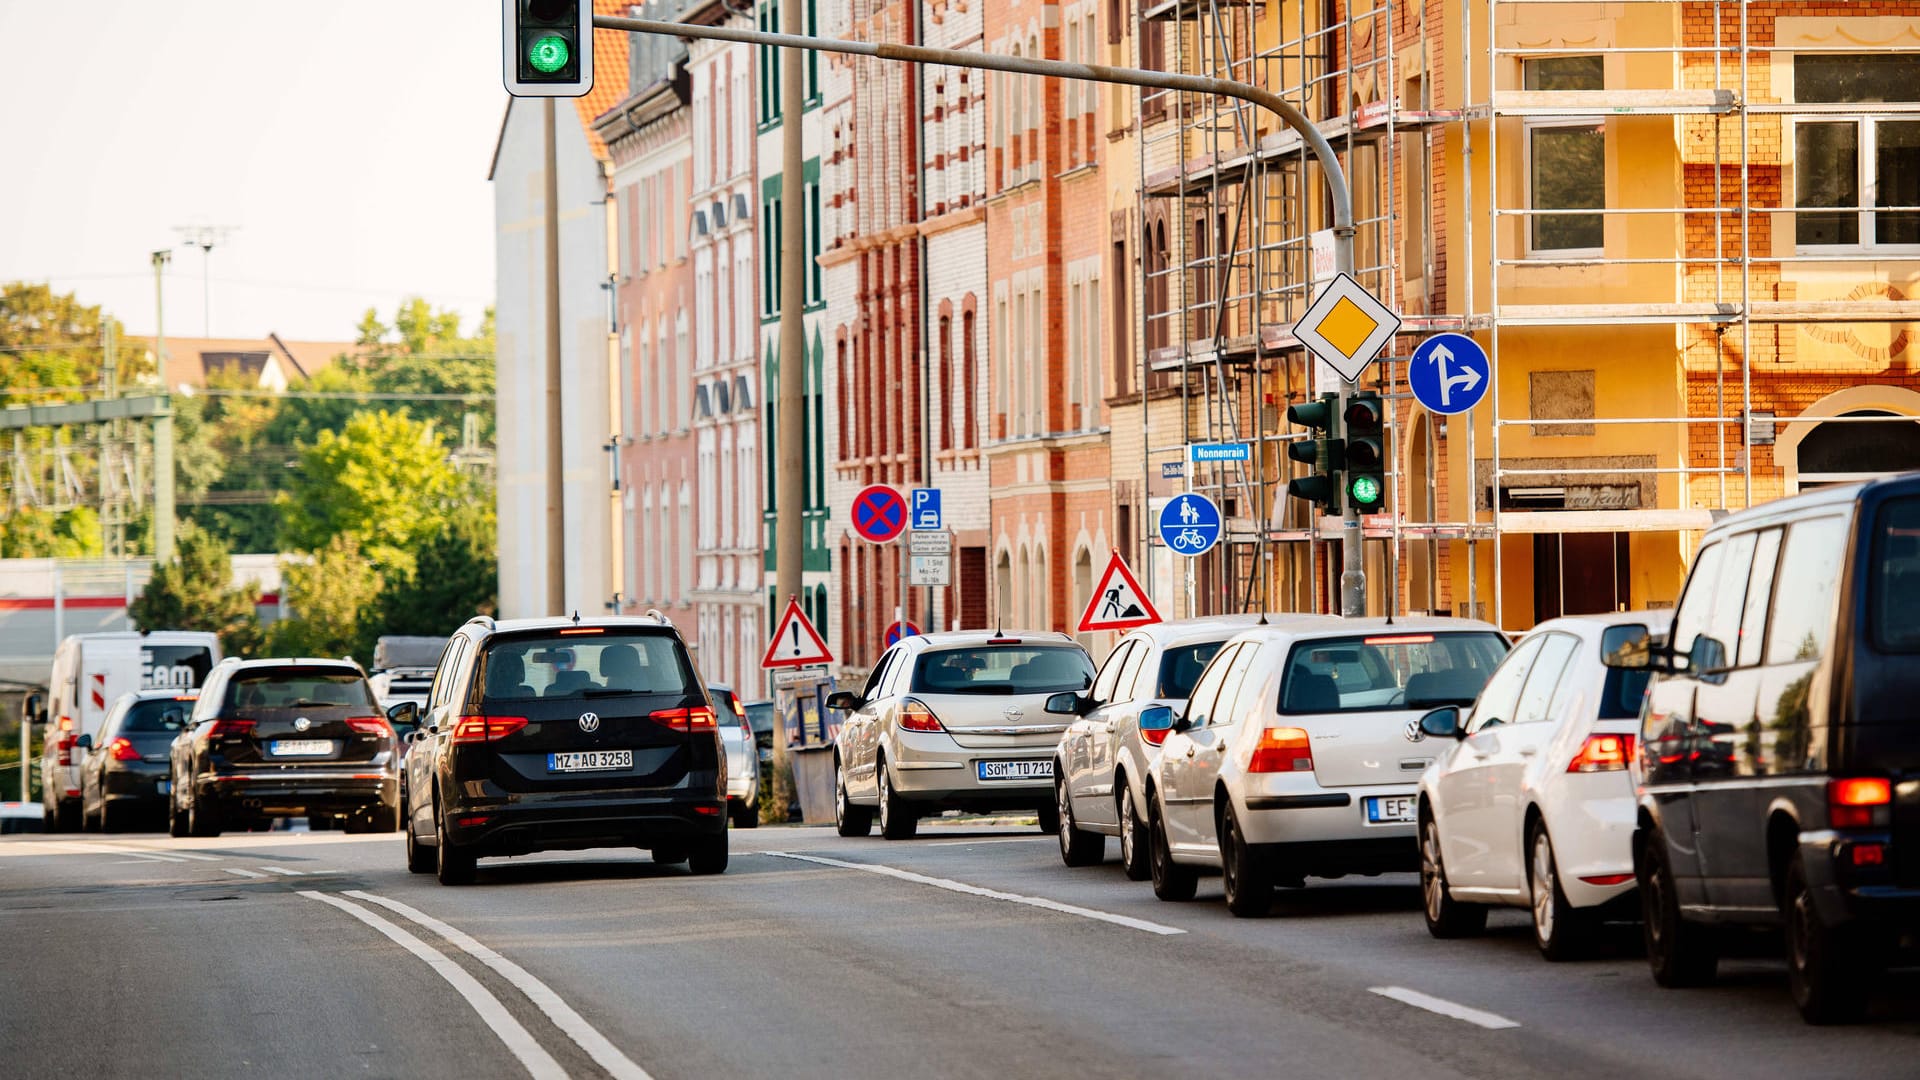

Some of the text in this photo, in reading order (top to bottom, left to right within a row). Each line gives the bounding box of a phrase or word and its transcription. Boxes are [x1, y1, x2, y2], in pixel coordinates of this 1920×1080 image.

[1197, 447, 1245, 459] Nonnenrain
[916, 491, 929, 509] P
[555, 754, 571, 768] MZ
[581, 753, 597, 767] AQ
[600, 752, 630, 766] 3258
[1016, 763, 1030, 775] TD
[1032, 762, 1052, 774] 712
[1386, 799, 1408, 816] EF
